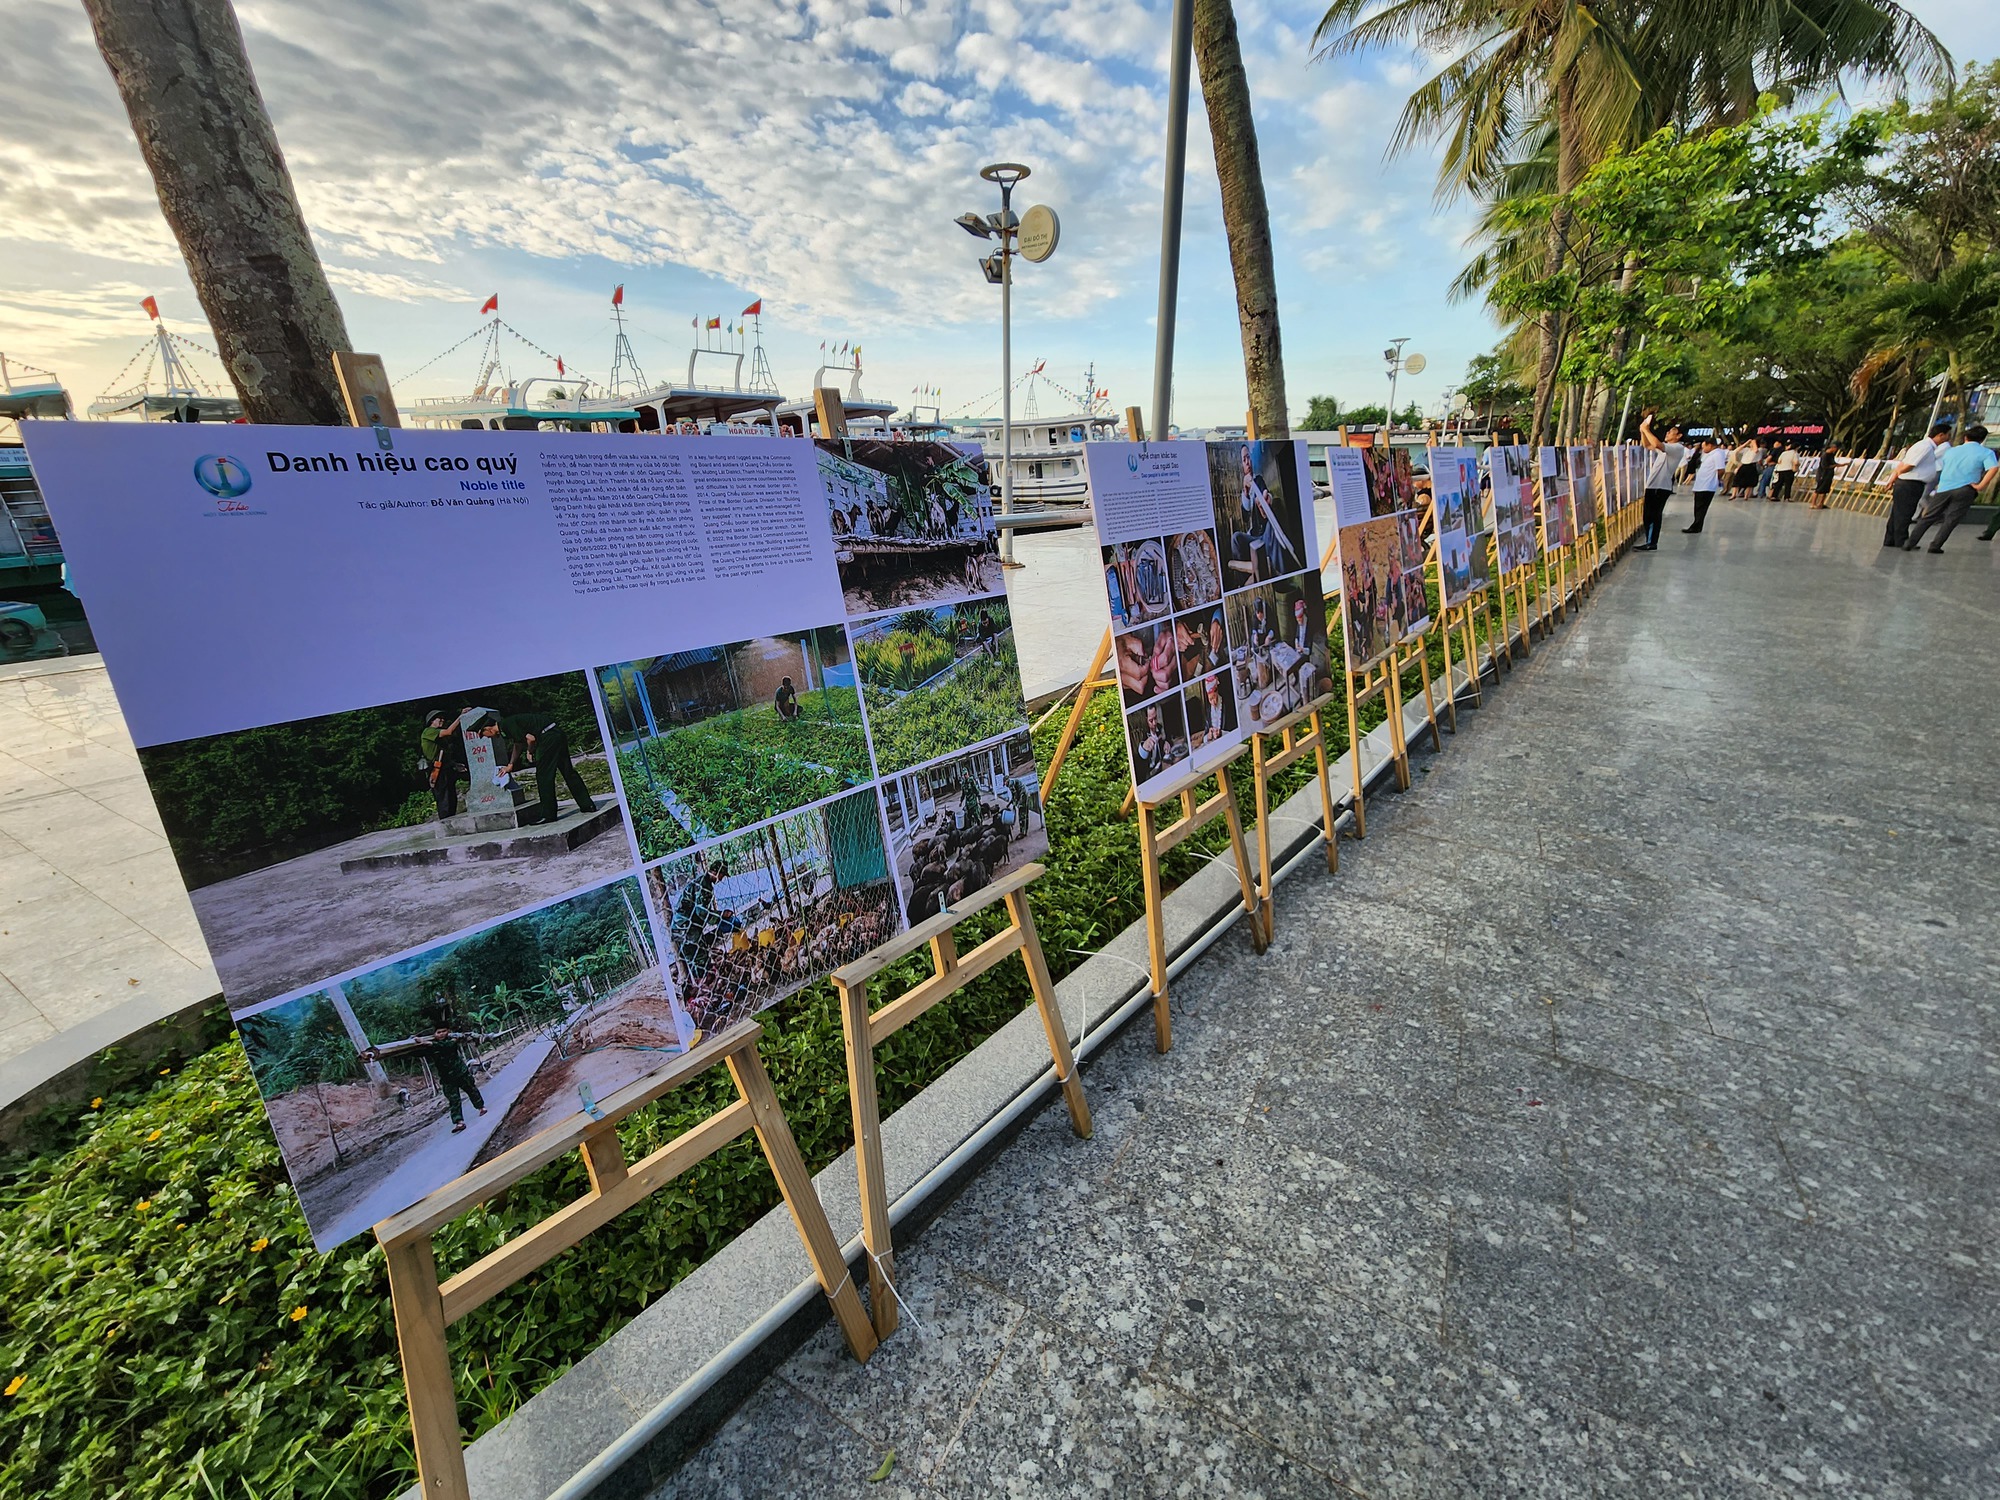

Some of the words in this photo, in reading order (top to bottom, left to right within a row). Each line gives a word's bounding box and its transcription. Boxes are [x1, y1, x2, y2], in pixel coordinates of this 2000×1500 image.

[266, 451, 349, 473] Danh
[358, 452, 418, 476] hiệu
[428, 457, 470, 472] cao
[476, 452, 518, 475] quý
[460, 478, 498, 492] Noble
[502, 478, 526, 491] title
[358, 500, 377, 510] Tác
[379, 498, 428, 511] giả/Author:
[430, 497, 444, 507] Đỗ
[445, 497, 464, 507] Văn
[466, 496, 495, 508] Quảng
[496, 496, 511, 506] (Hà
[512, 495, 530, 506] Nội)
[472, 745, 486, 755] 294
